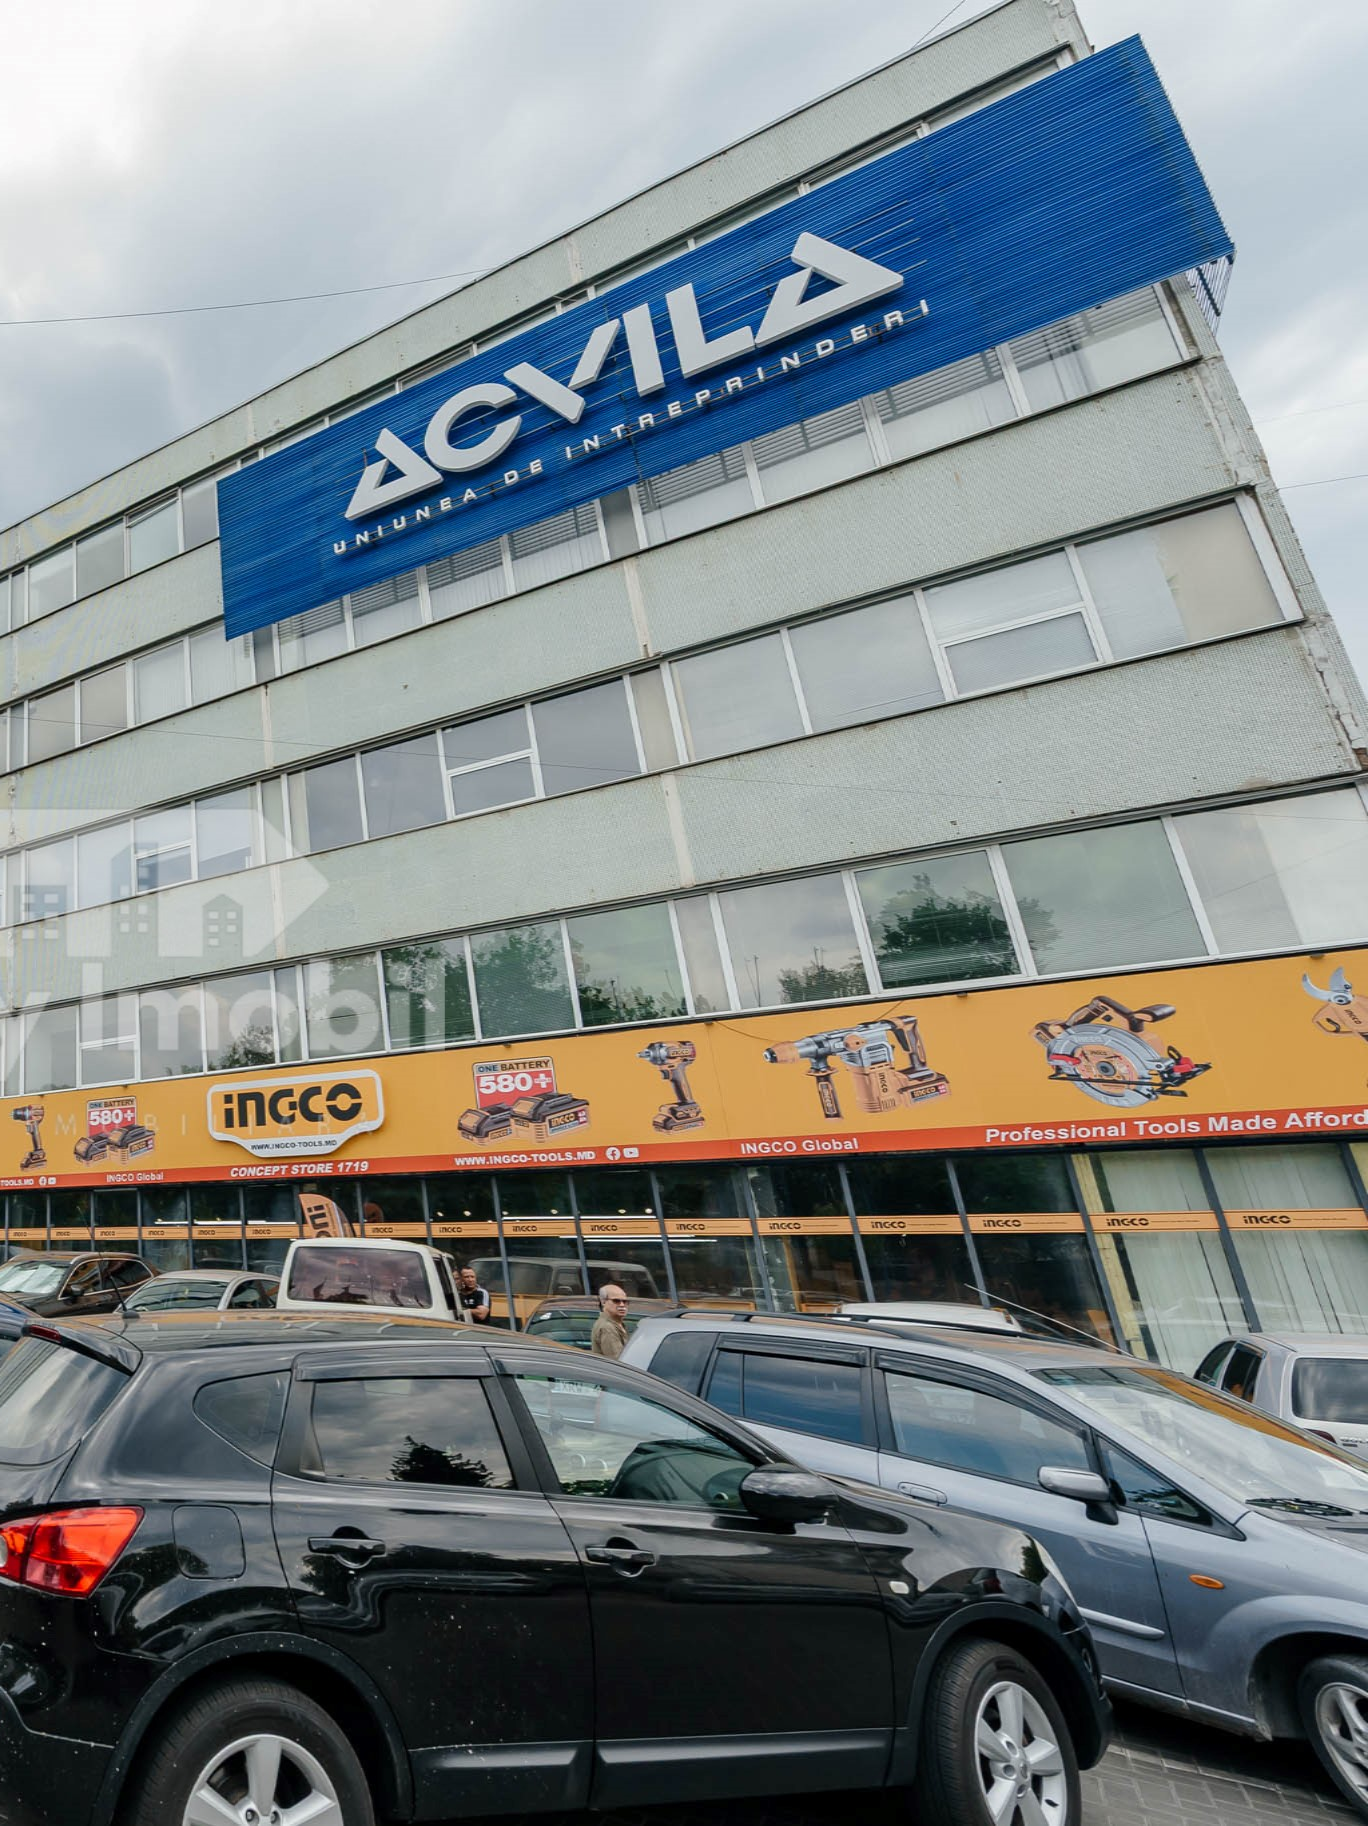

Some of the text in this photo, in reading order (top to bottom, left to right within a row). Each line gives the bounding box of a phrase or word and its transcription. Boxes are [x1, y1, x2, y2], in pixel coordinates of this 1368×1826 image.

[344, 231, 905, 521] ACVILA
[333, 299, 931, 556] UNIUNEA DE INTREPRINDERI
[477, 1060, 550, 1073] ONE BATTERY
[479, 1073, 553, 1094] 580+
[103, 1099, 135, 1108] BATTERY
[89, 1109, 135, 1126] 580+
[985, 1122, 1126, 1143] Professional
[1133, 1117, 1201, 1137] Tools
[1208, 1114, 1277, 1132] Made
[740, 1137, 859, 1155] INGCO Global
[455, 1150, 596, 1167] WWW.INGCO-TOOLS.MD
[106, 1171, 164, 1183] INGCO Global
[230, 1161, 370, 1178] CONCEPT STORE 1719
